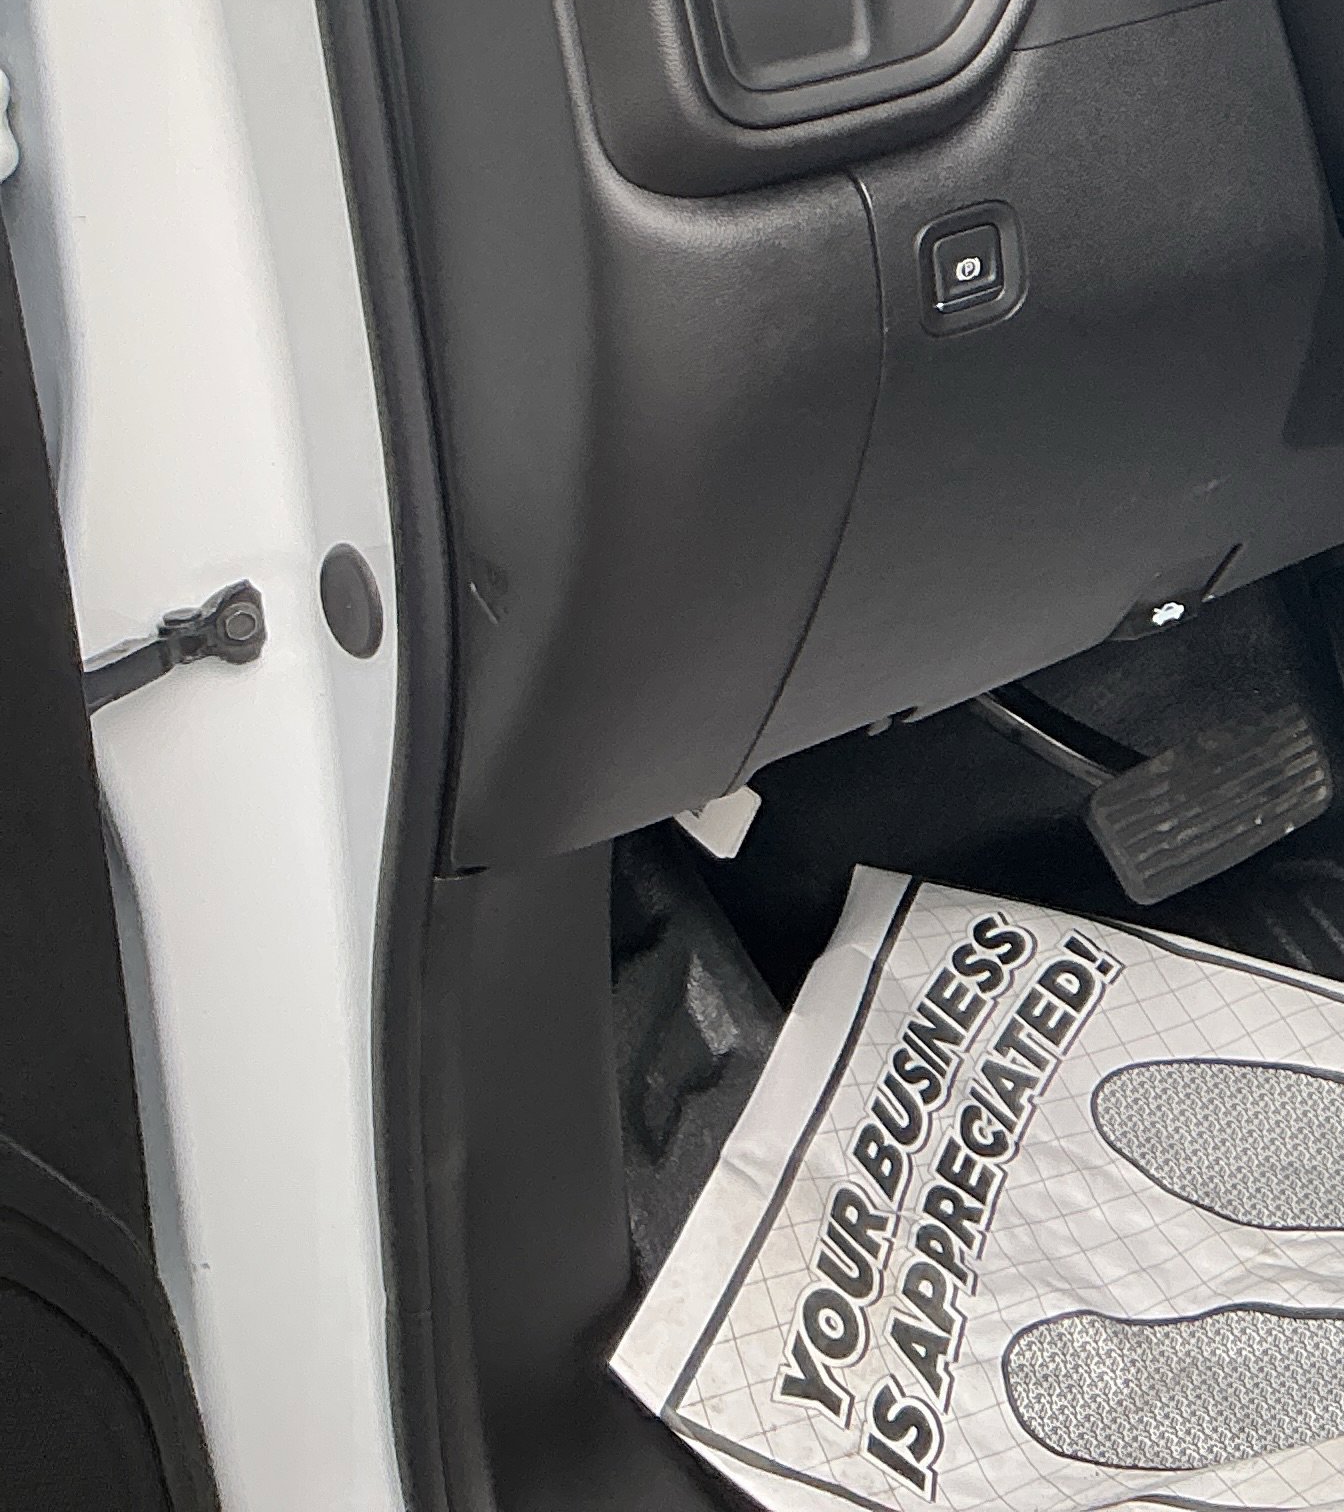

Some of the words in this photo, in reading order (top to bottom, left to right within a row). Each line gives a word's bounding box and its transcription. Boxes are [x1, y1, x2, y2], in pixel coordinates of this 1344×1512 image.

[774, 1187, 890, 1428] YOUR
[852, 910, 1036, 1208] BUSINESS
[884, 928, 1125, 1412] APPRECIATED!
[863, 1393, 938, 1502] IS
